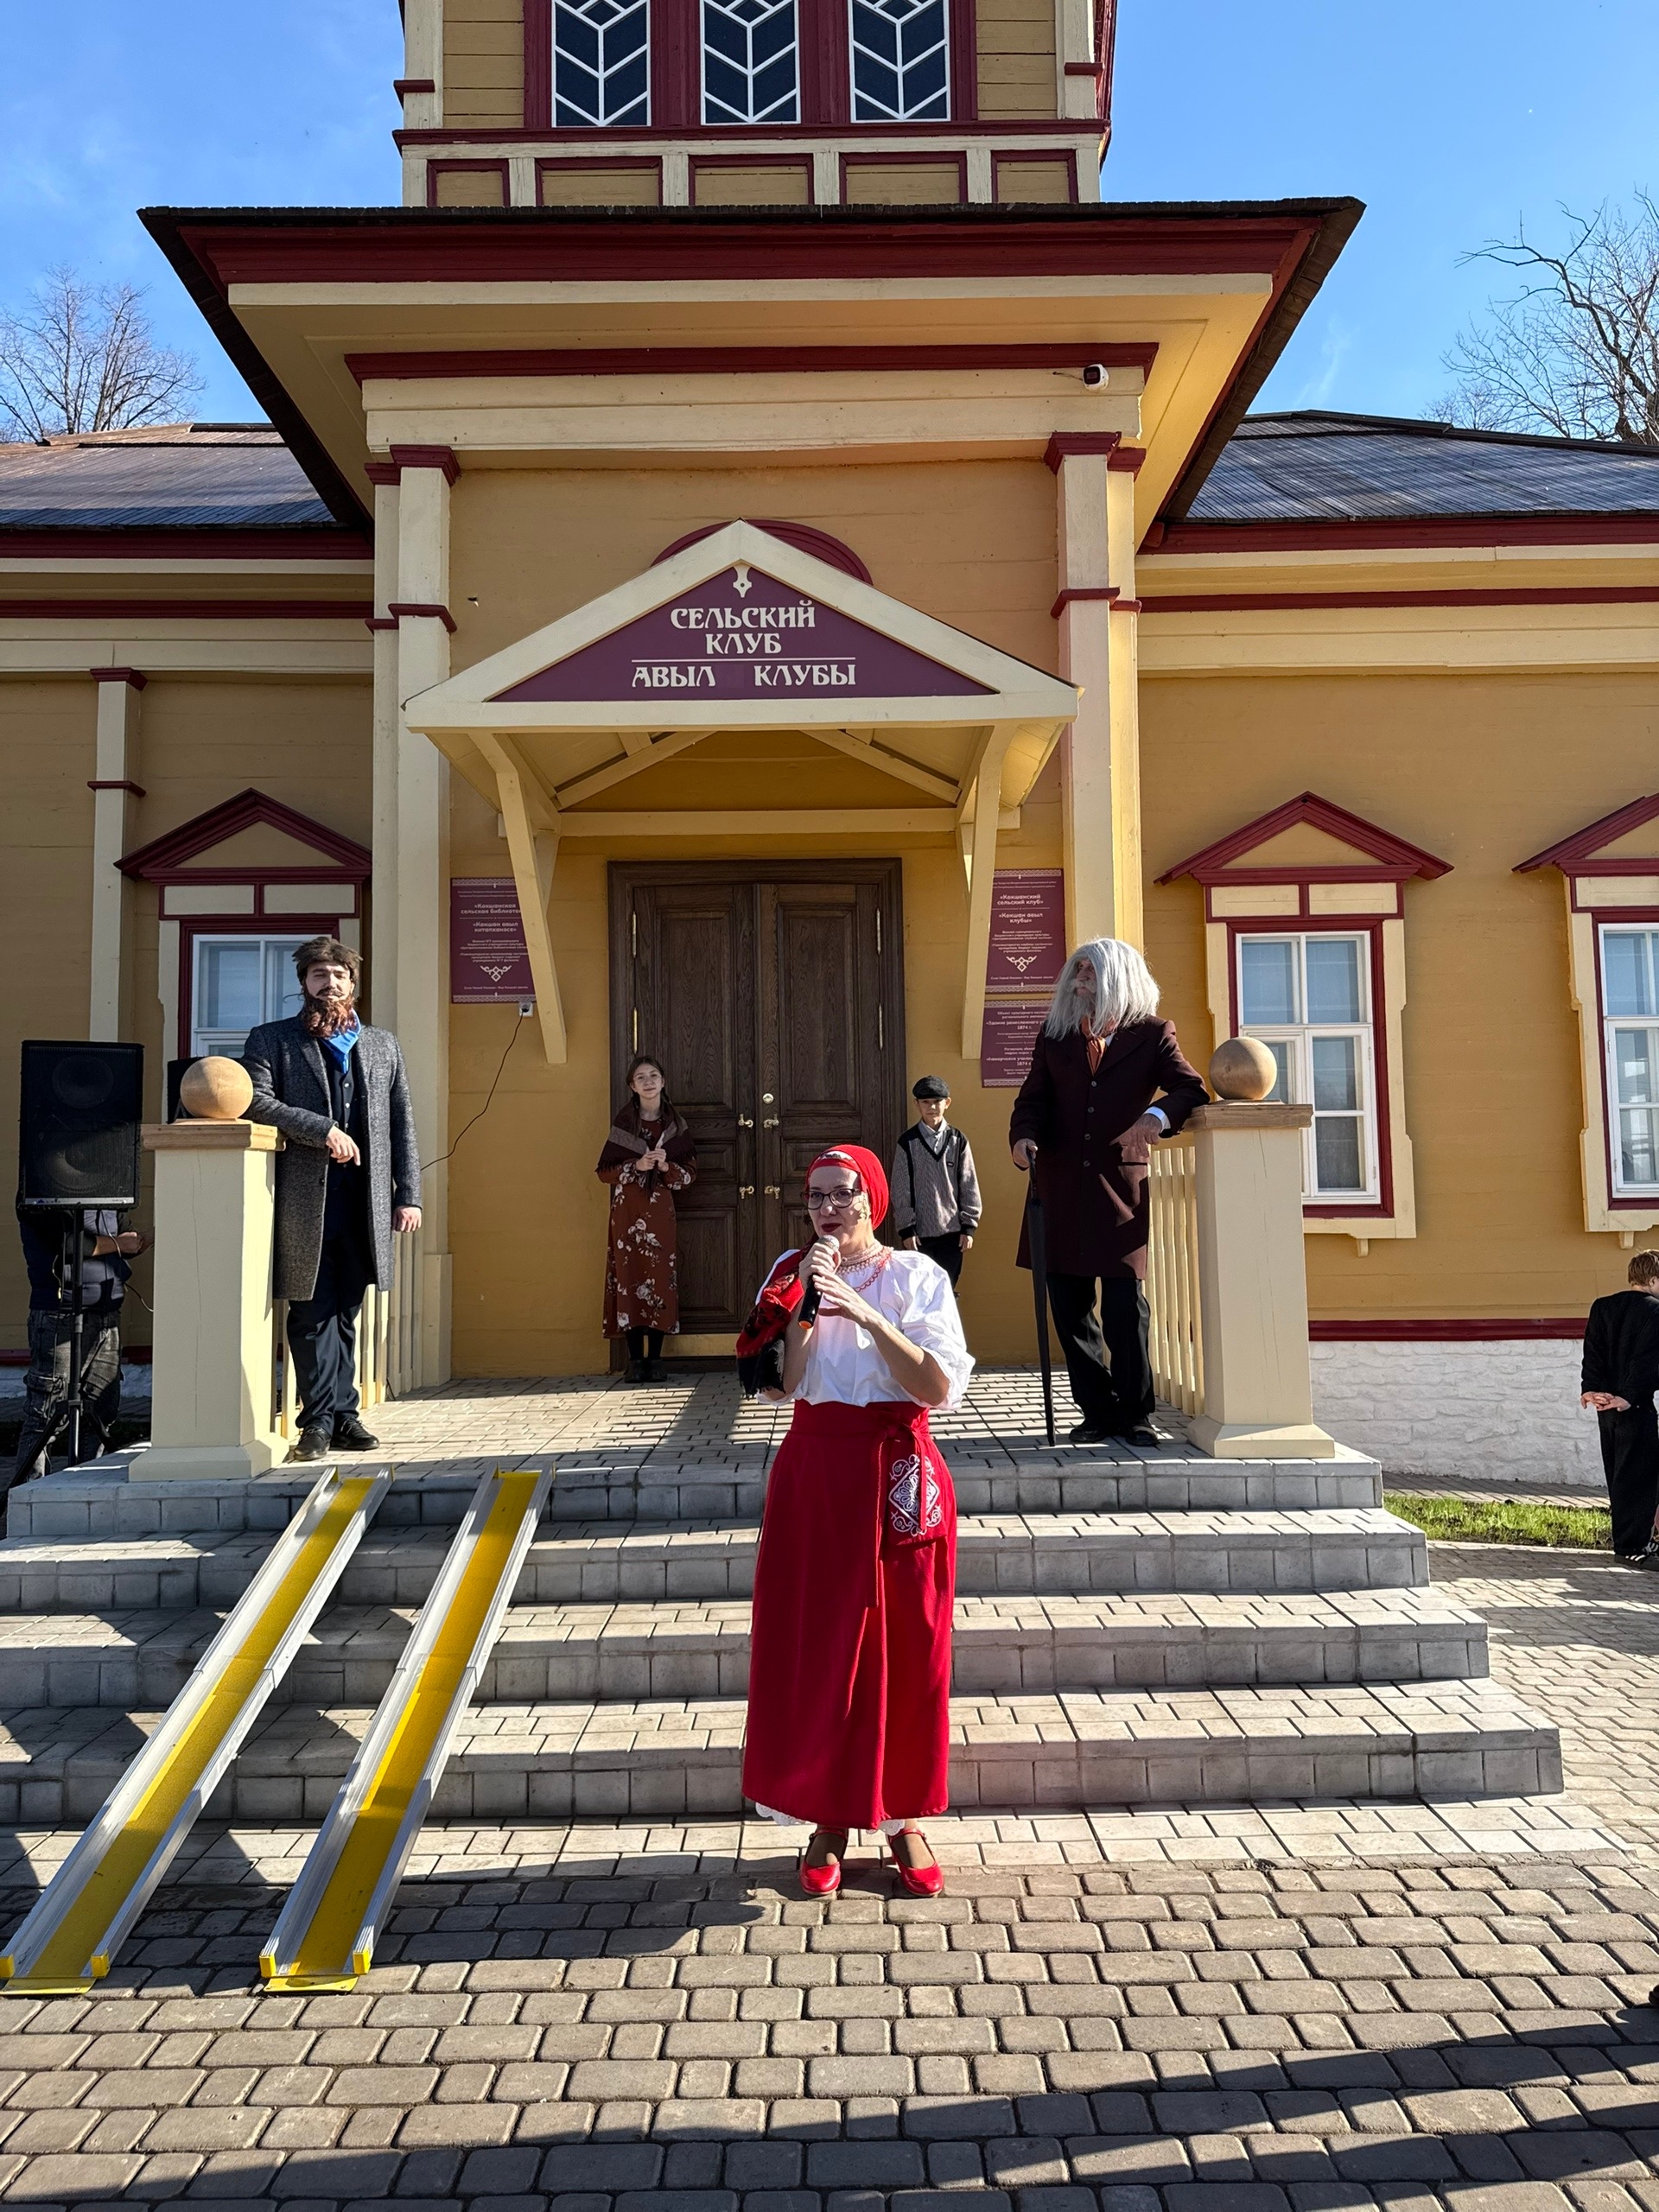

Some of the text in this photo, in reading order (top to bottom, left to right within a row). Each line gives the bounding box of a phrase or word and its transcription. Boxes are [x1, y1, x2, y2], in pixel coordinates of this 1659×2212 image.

[671, 600, 816, 629] СЕЛЬСКИЙ
[705, 632, 782, 654] КЛУБ
[632, 664, 856, 687] АВЫЛ КЛУБЫ
